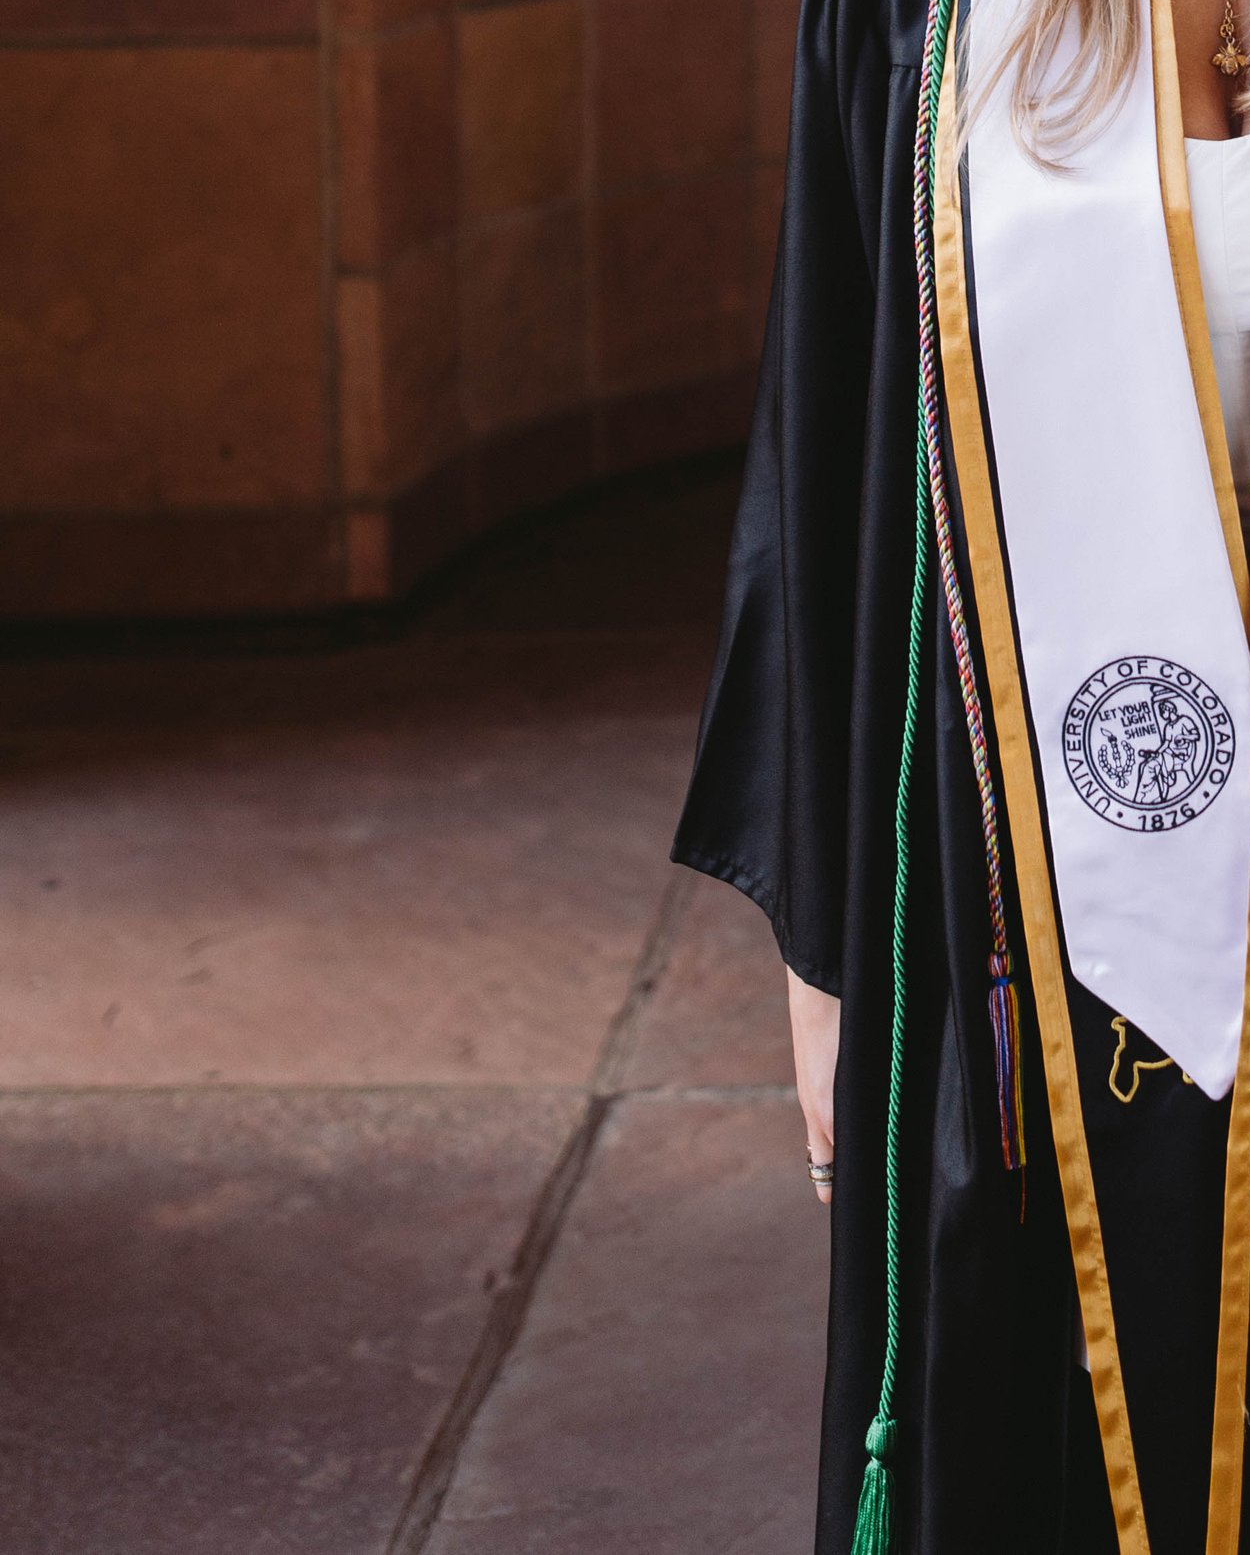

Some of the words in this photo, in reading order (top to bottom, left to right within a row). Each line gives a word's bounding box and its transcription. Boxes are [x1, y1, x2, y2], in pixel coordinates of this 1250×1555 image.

[1098, 707, 1118, 722] LET
[1118, 700, 1150, 718] YOUR
[1120, 712, 1152, 728] LIGHT
[1066, 671, 1111, 814] UNIVERSITY
[1117, 659, 1149, 678] OF
[1159, 663, 1231, 785] COLORADO
[1124, 723, 1157, 740] SHINE
[1138, 803, 1196, 832] 1876
